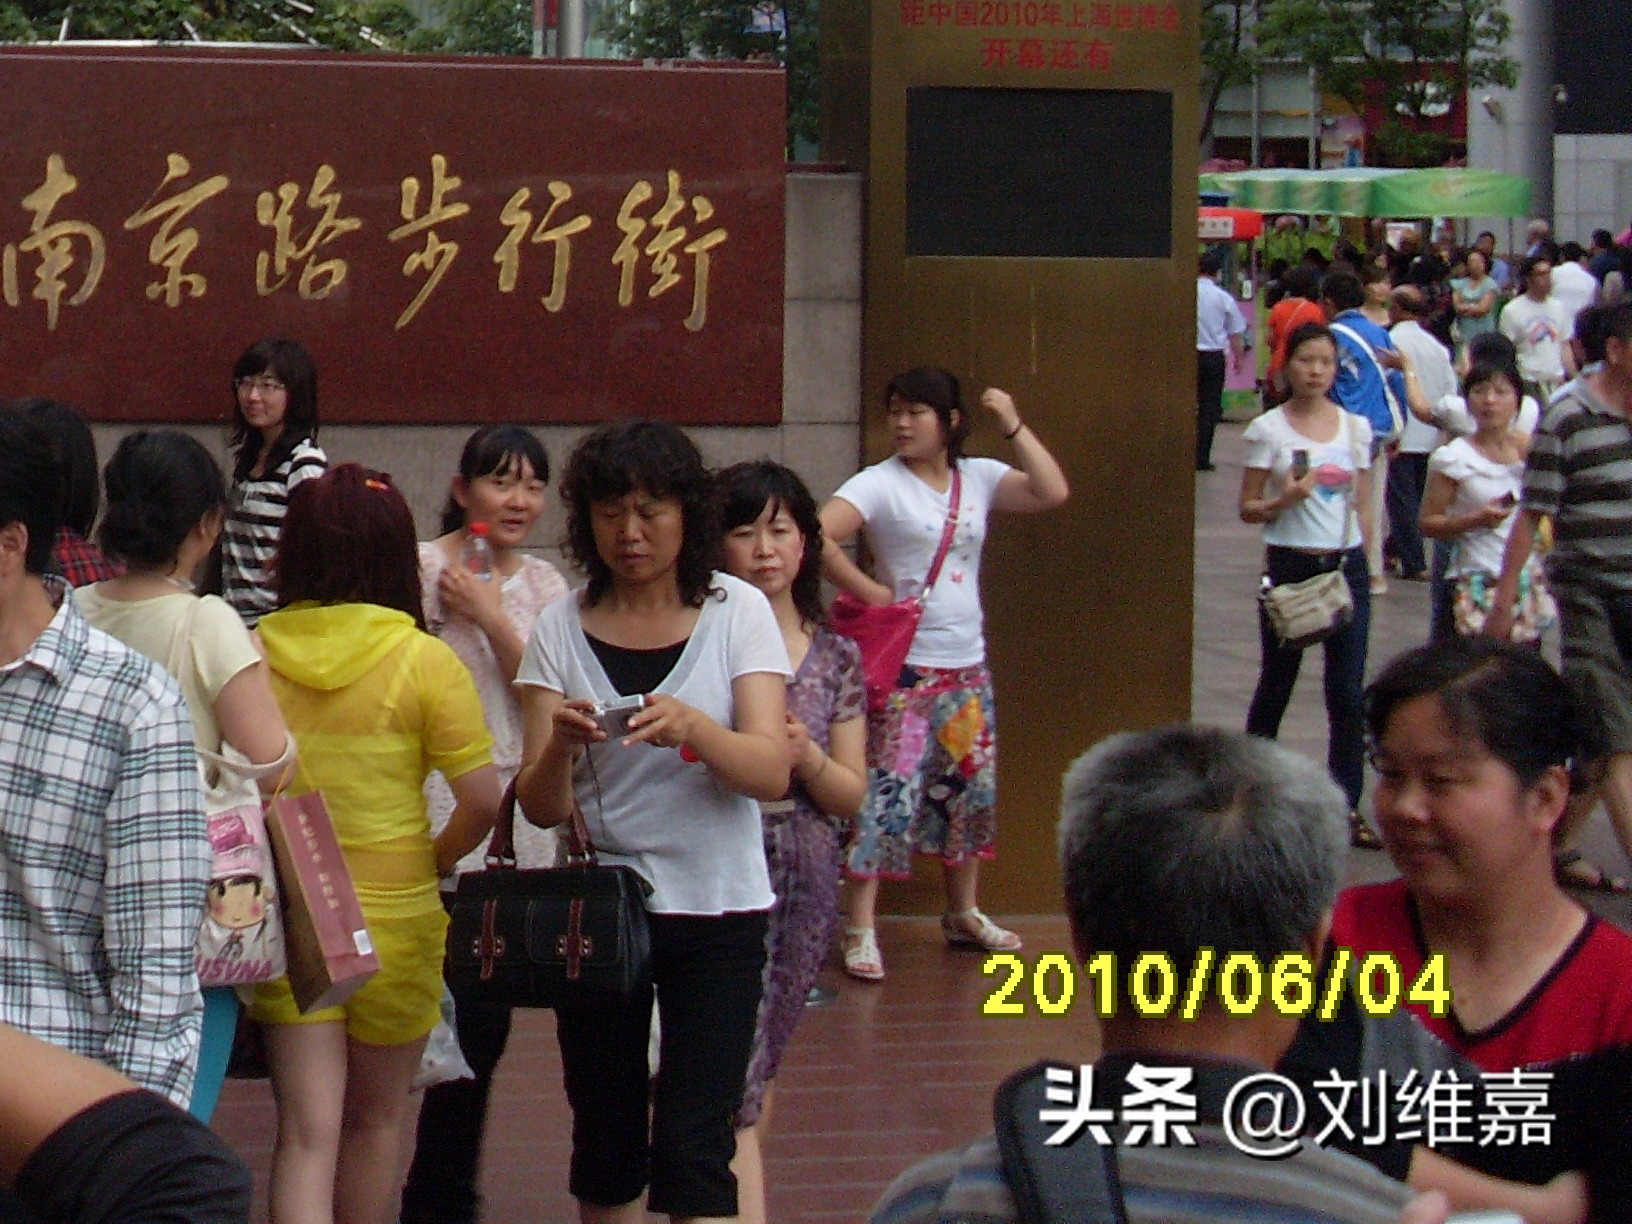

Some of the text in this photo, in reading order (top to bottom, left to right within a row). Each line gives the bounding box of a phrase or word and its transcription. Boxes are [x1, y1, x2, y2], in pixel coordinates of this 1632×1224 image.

[979, 38, 1114, 72] 开幕还有
[1, 151, 729, 332] 南京路步行街
